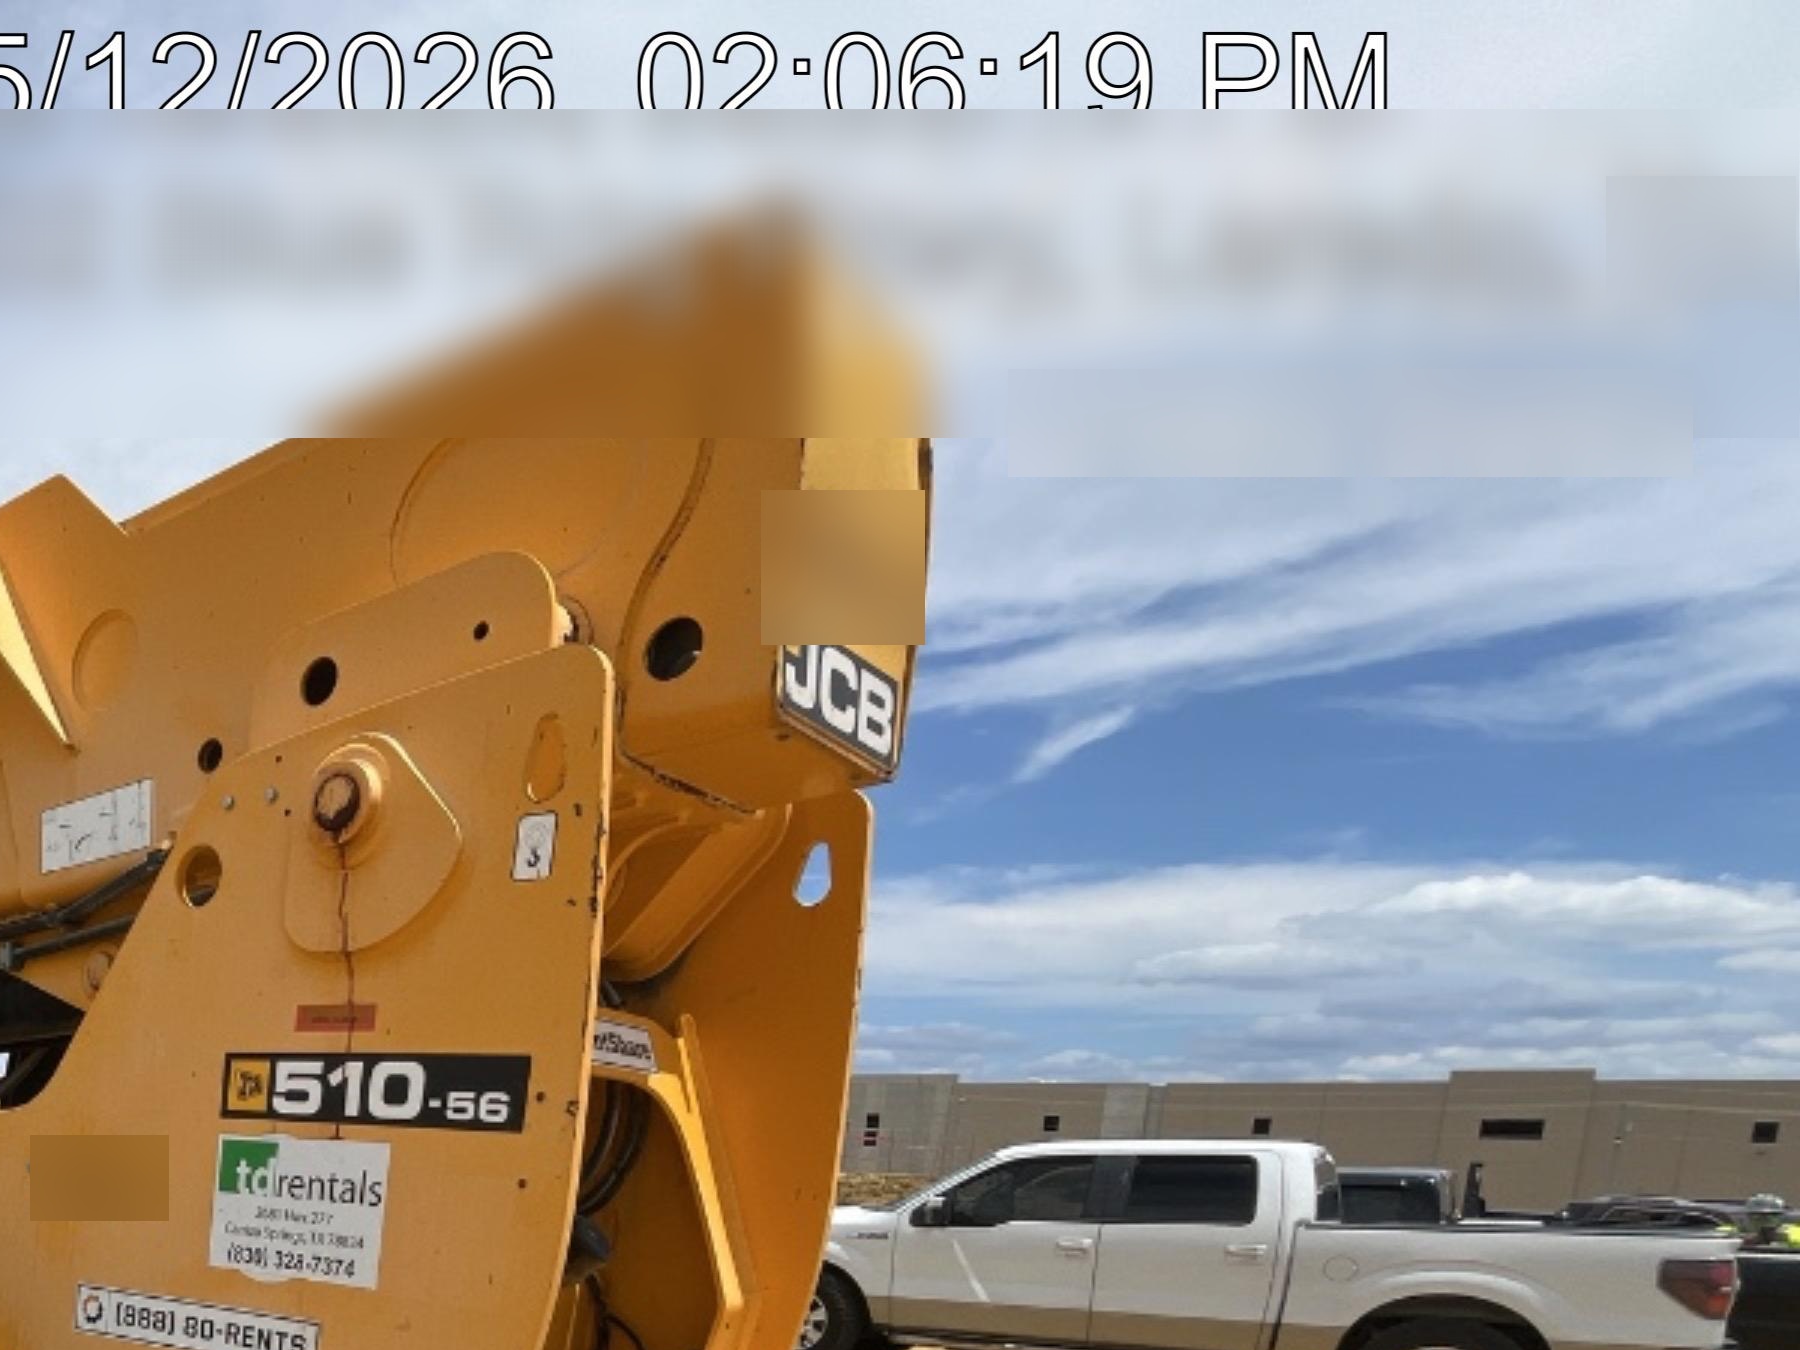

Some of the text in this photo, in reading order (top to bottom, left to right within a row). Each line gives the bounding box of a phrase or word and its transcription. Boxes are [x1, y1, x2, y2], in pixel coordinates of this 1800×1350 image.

[785, 645, 894, 756] JCB
[272, 1060, 512, 1123] 510-56
[116, 1302, 175, 1335] (888)
